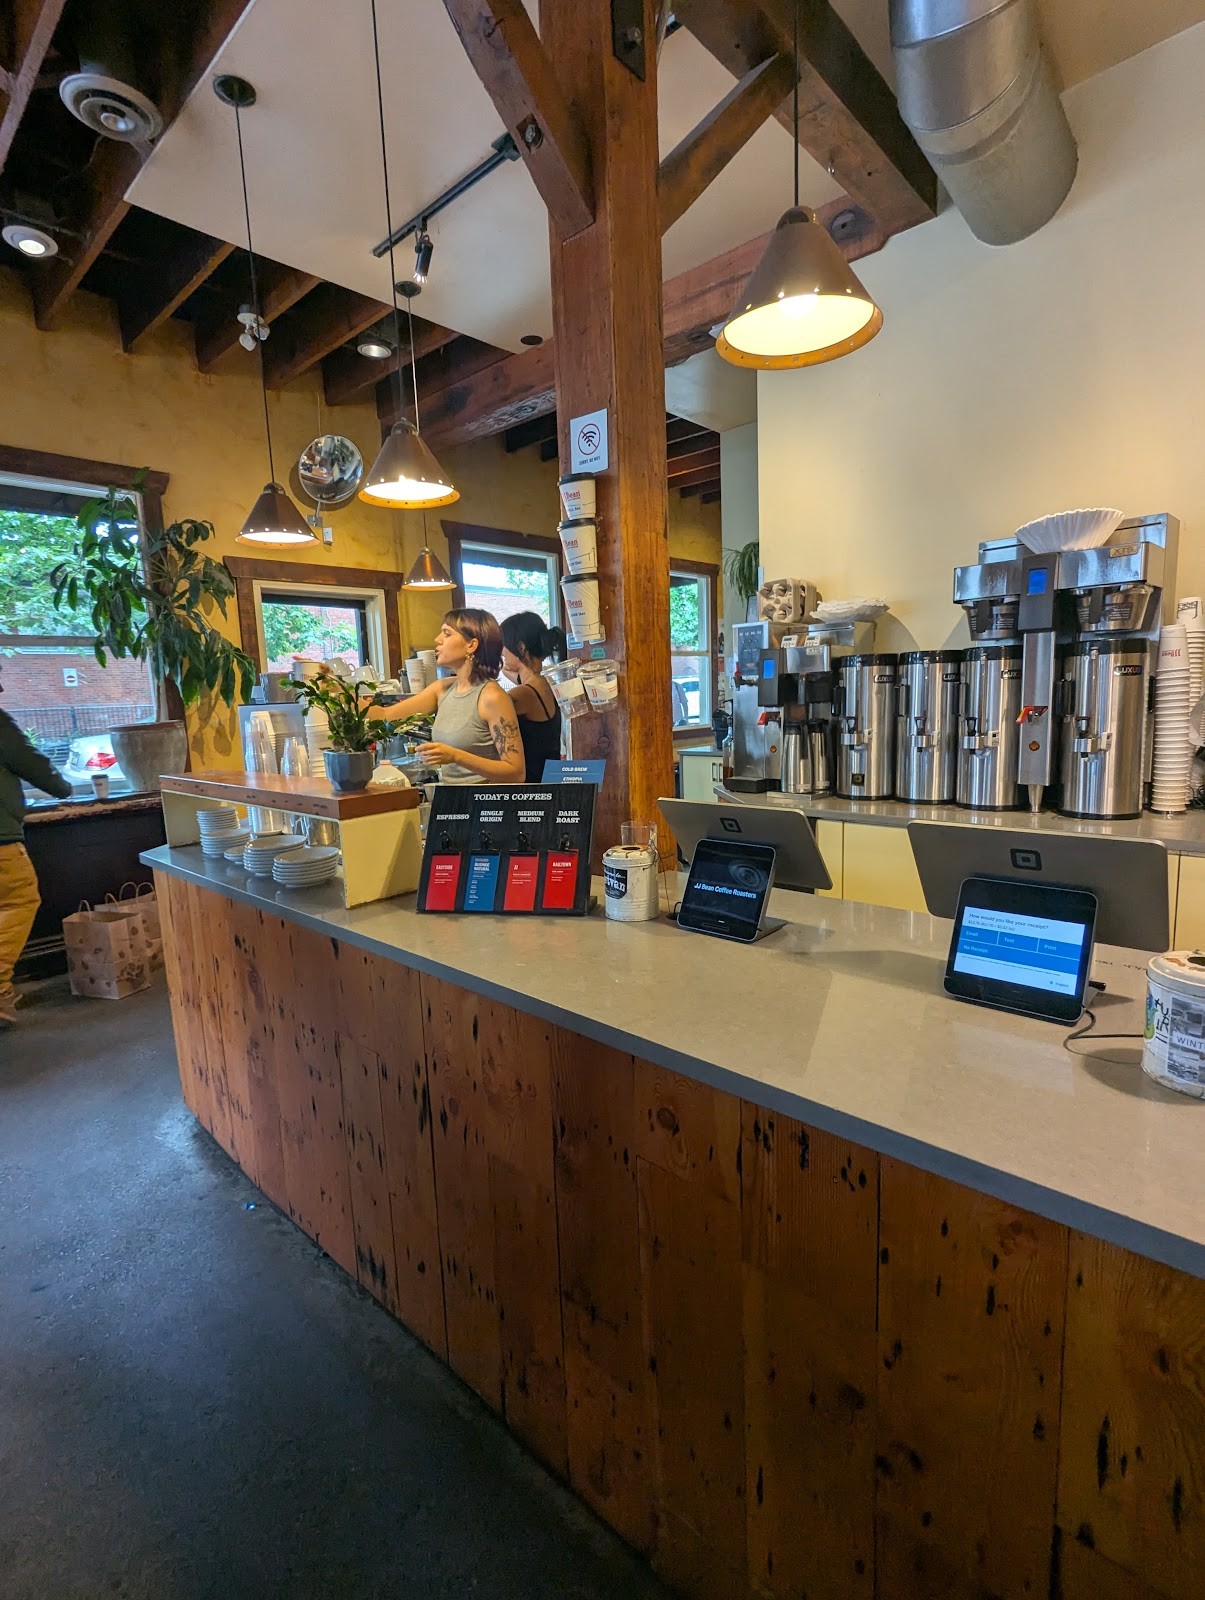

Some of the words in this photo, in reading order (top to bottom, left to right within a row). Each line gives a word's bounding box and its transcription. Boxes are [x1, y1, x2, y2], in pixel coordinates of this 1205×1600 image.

[702, 884, 714, 892] Bean
[714, 886, 732, 894] Coffee
[732, 888, 757, 898] Roasters
[971, 946, 988, 954] Receipt
[1176, 1035, 1205, 1049] WINT
